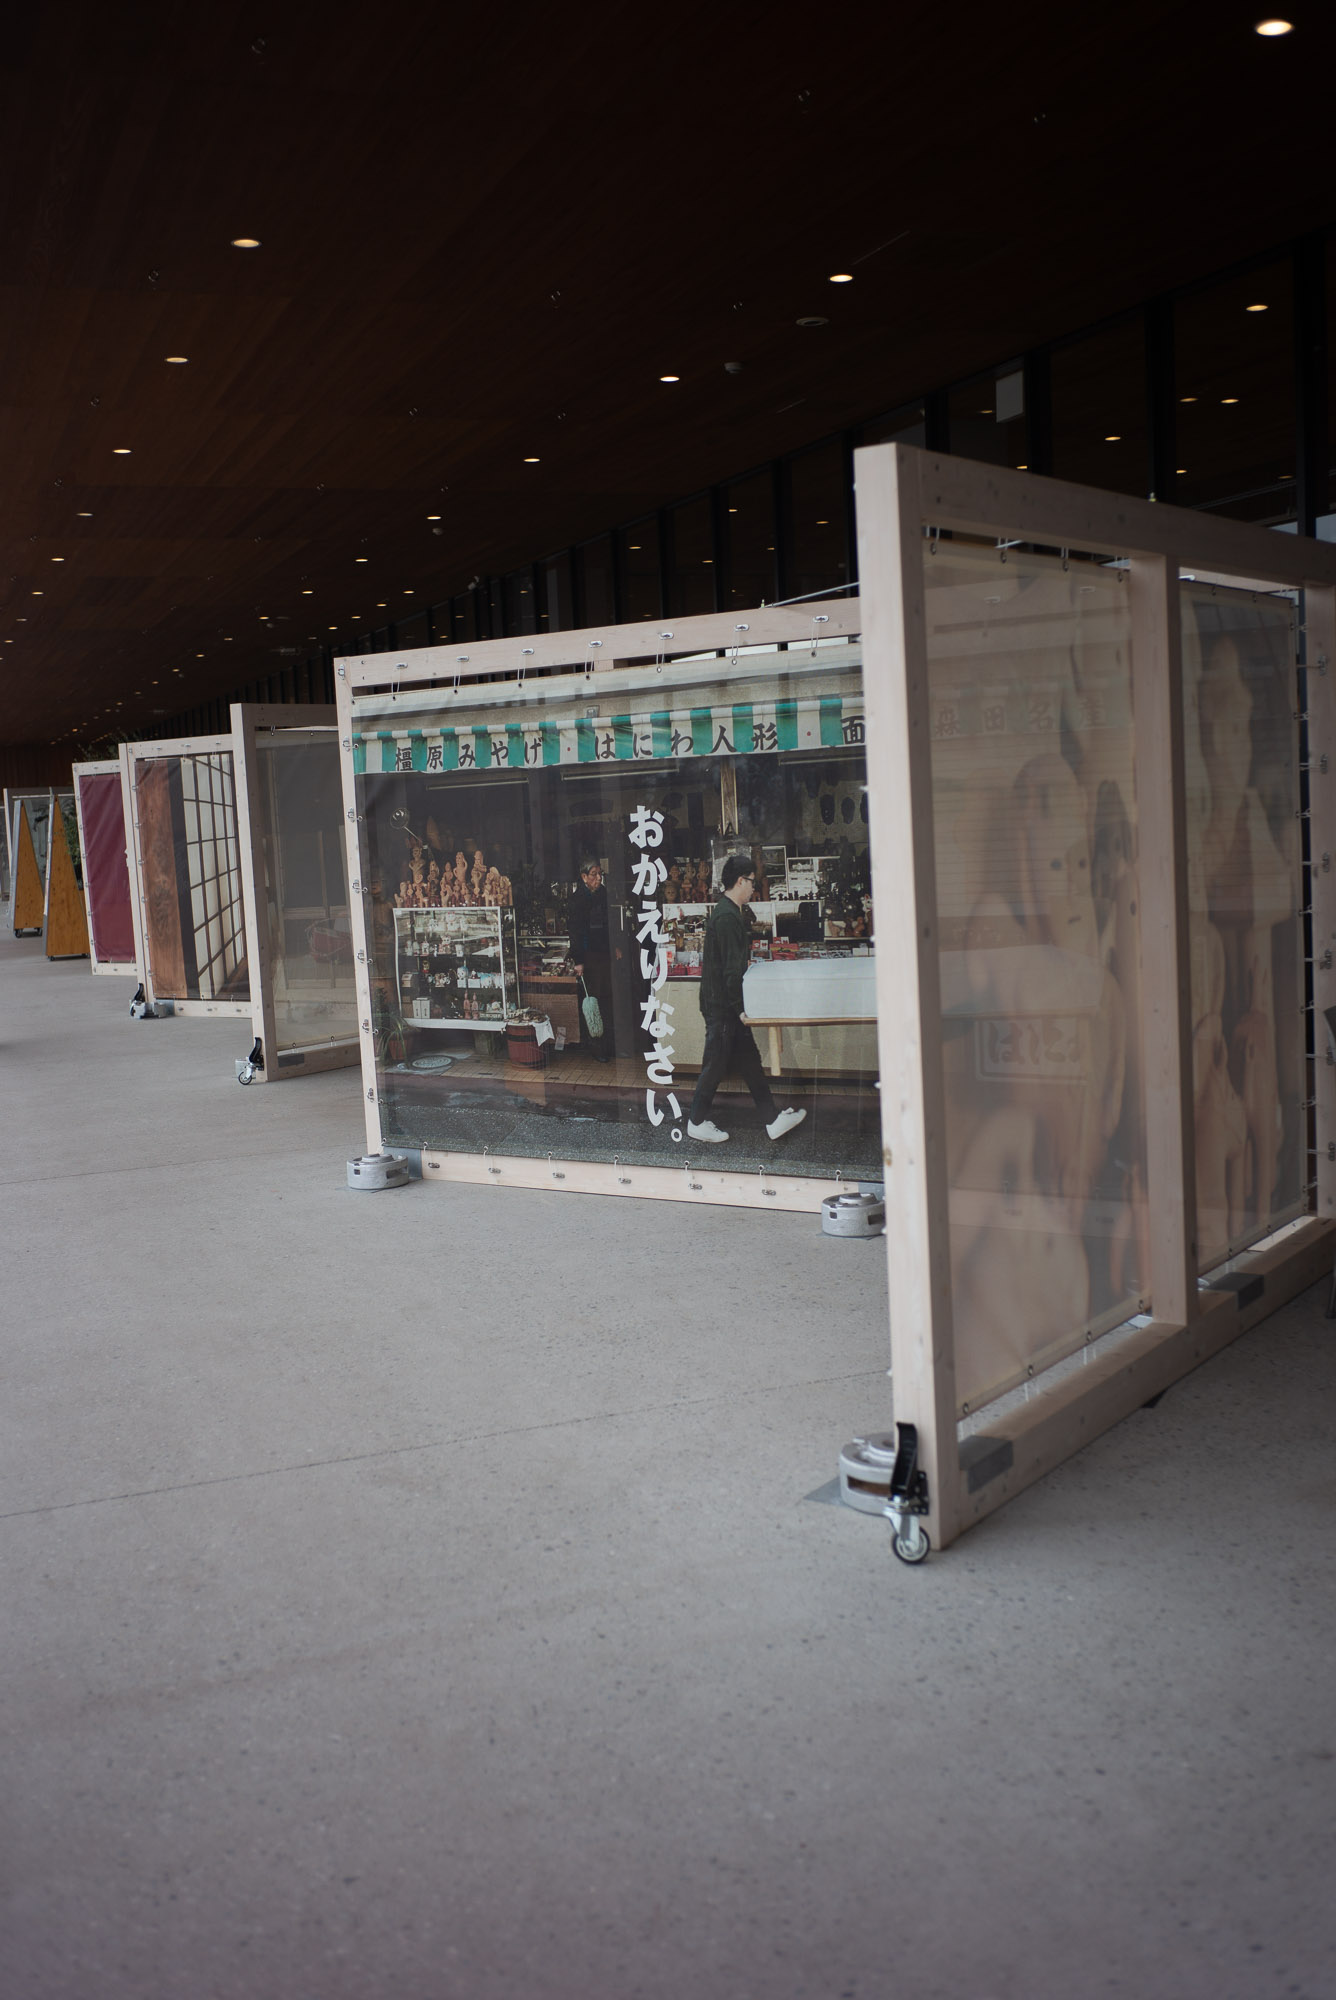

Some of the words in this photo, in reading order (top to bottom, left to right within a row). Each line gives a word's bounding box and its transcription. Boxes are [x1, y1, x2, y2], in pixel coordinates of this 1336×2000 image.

[628, 804, 683, 1143] おかえりなさい。
